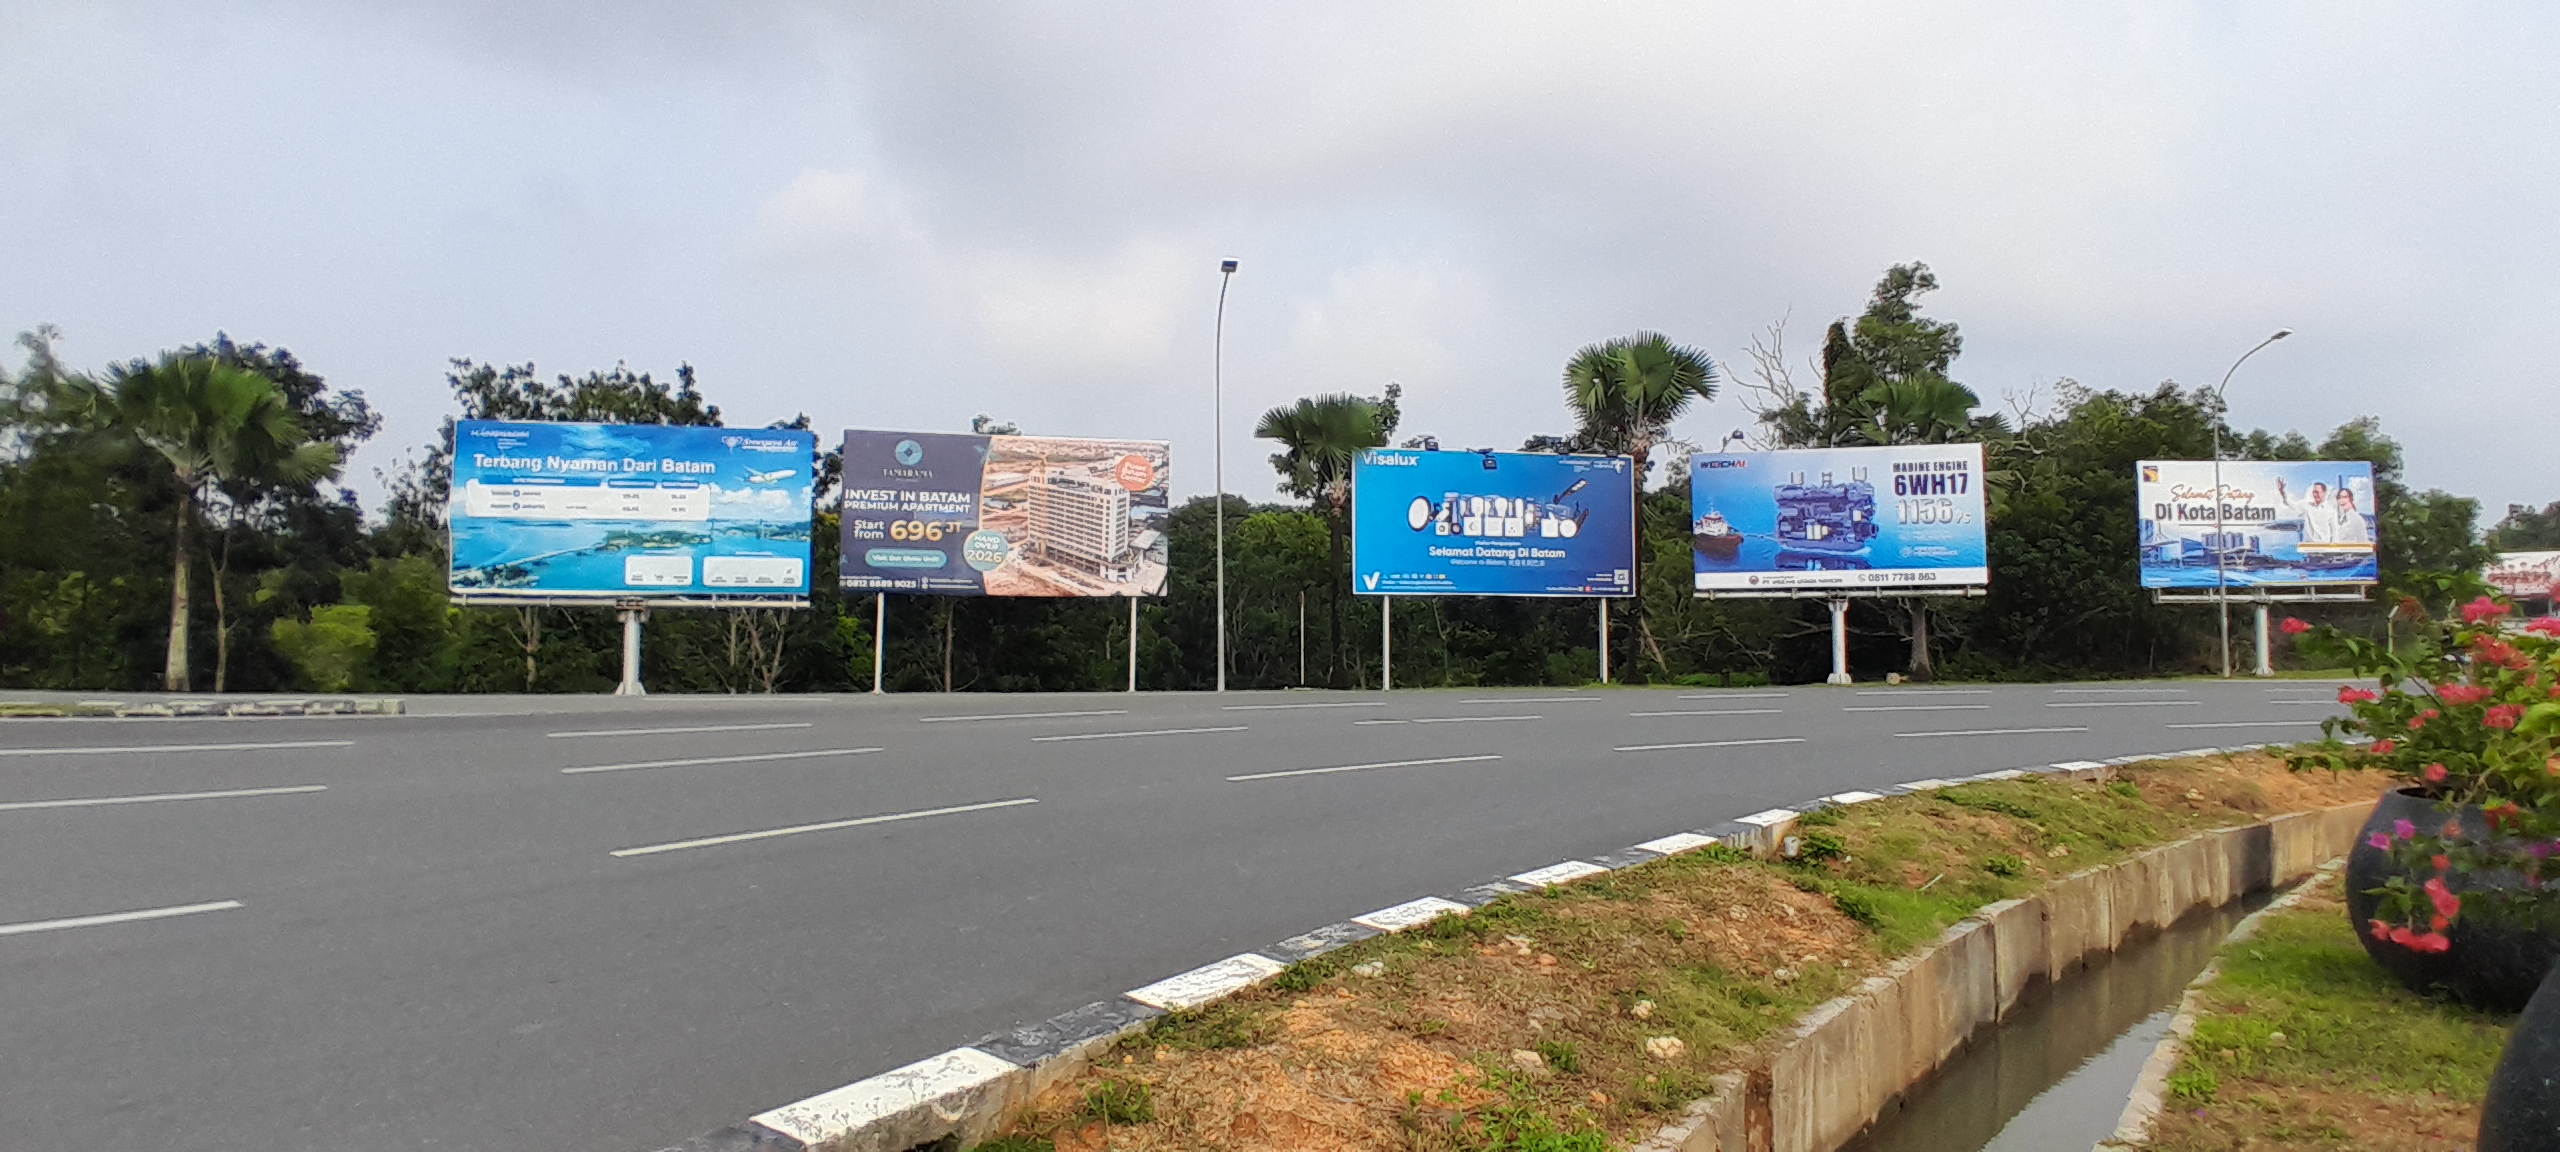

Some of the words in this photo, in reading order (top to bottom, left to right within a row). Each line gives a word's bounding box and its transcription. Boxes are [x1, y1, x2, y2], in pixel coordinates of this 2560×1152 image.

[473, 453, 542, 472] Terbang
[547, 455, 618, 473] Nyaman
[622, 457, 657, 473] Dari
[661, 458, 716, 474] Batam
[1361, 451, 1418, 466] Visalux
[1893, 462, 1930, 472] MARINE
[1933, 460, 1968, 471] ENGINE
[1894, 473, 1968, 496] 6WH17
[845, 489, 897, 501] INVEST
[900, 490, 916, 501] IN
[919, 492, 971, 503] BATAM
[844, 501, 899, 511] PREMIUM
[901, 503, 971, 513] APARTMENT
[2155, 503, 2172, 520] Di
[2177, 503, 2216, 520] Kota
[2222, 504, 2276, 520] Batam
[854, 520, 884, 530] Start
[890, 520, 943, 541] 696
[854, 530, 884, 540] from
[966, 549, 1003, 563] 2026
[1428, 546, 1474, 557] Selamat
[1476, 546, 1516, 559] Datang
[1531, 548, 1566, 558] Batam
